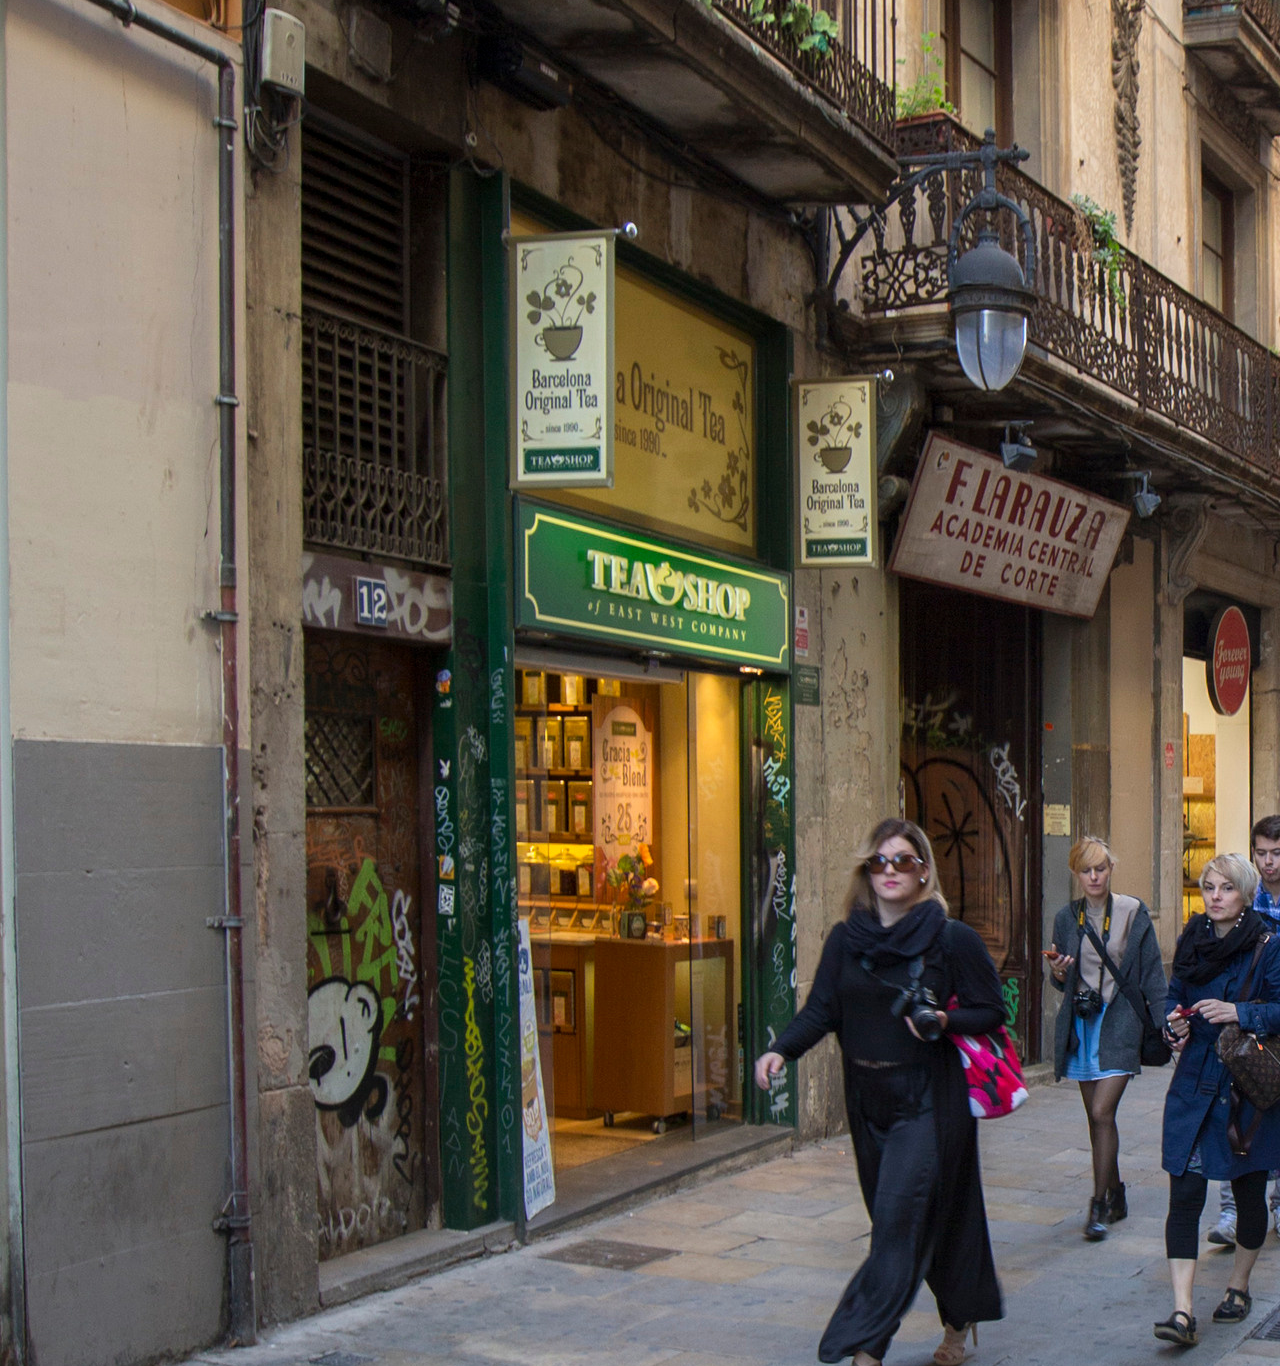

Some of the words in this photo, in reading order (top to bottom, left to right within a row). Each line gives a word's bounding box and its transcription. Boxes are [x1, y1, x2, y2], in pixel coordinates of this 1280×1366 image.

[532, 369, 591, 389] Barcelona
[525, 390, 572, 414] Original
[576, 389, 598, 408] Tea
[631, 362, 694, 433] Original
[699, 390, 727, 446] Tea
[545, 424, 562, 434] since
[563, 423, 579, 433] 1990
[639, 429, 661, 456] 1990
[531, 455, 552, 466] TEA
[564, 454, 594, 465] SHOP
[812, 479, 860, 495] Barcelona
[806, 495, 844, 514] Original
[847, 494, 865, 509] Tea
[811, 544, 828, 553] TEA
[838, 543, 862, 552] SHOP
[930, 510, 1025, 557] ACADEMIA
[1028, 539, 1095, 578] CENTRAL
[587, 549, 650, 601] TEA
[683, 573, 750, 621] SHOP
[959, 550, 987, 578] DE
[1001, 563, 1059, 596] CORTE
[359, 585, 387, 620] 12
[588, 600, 601, 615] of
[609, 602, 642, 621] EAST
[651, 611, 683, 630] WEST
[691, 620, 747, 642] COMPANY
[1216, 640, 1247, 669] Forever
[1220, 663, 1245, 688] young
[602, 738, 630, 762] Gracia
[622, 764, 647, 787] Blend
[617, 802, 632, 832] 25
